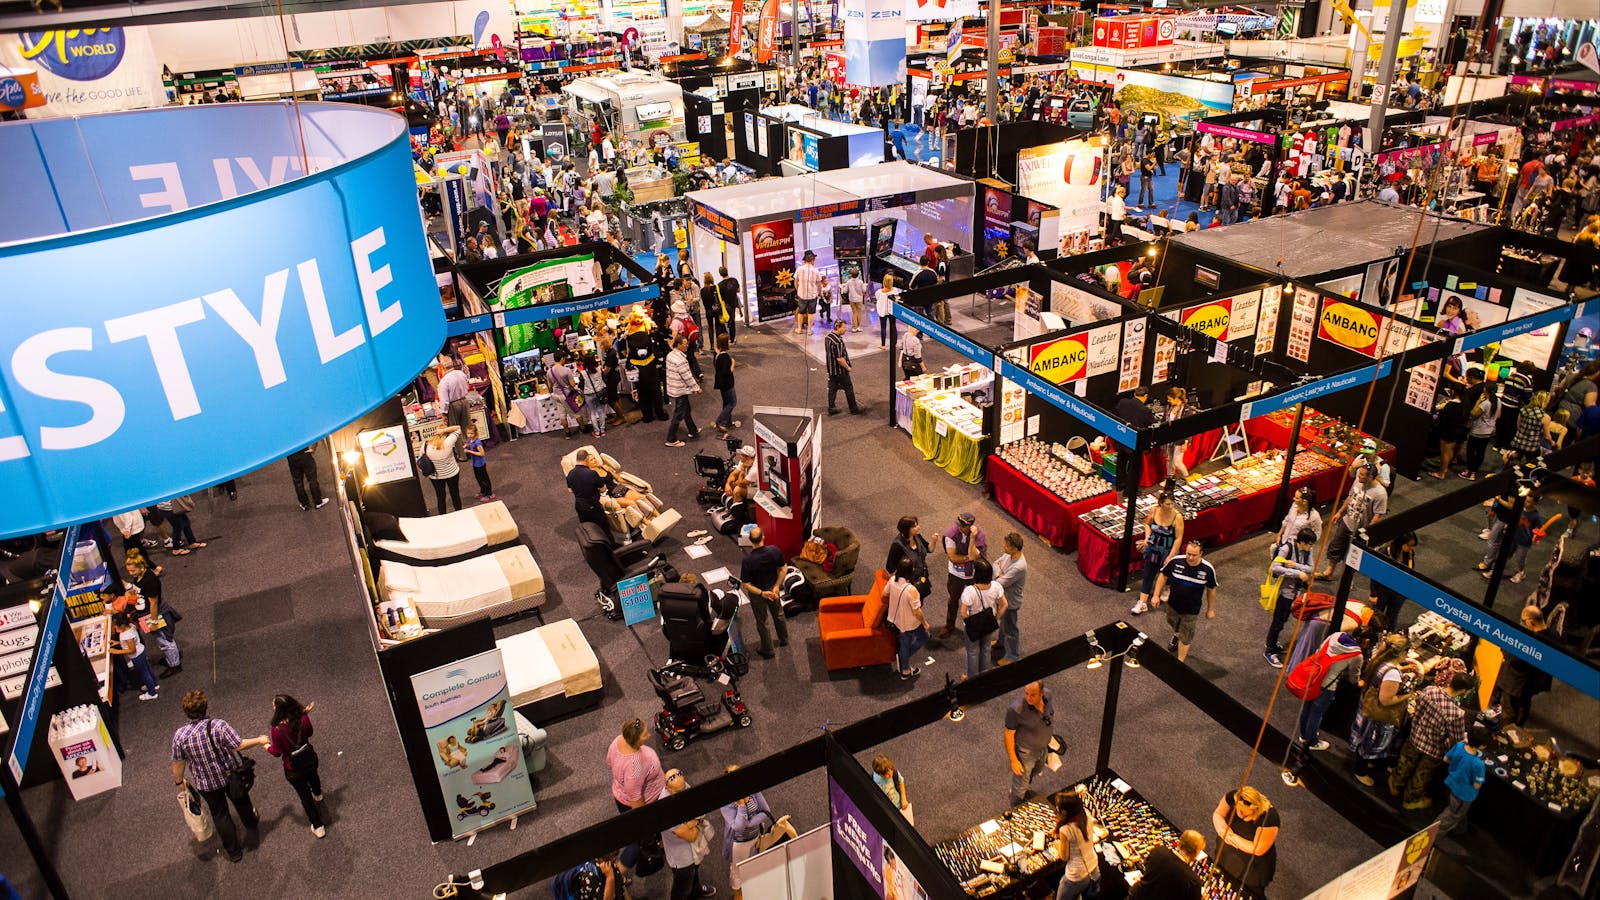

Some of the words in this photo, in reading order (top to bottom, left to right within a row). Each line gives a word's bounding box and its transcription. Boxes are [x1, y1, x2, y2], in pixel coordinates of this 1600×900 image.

[848, 10, 864, 18] ZEN
[871, 10, 901, 18] ZEN
[1163, 26, 1171, 34] 25
[70, 43, 117, 57] WORLD
[45, 91, 63, 103] ive
[66, 87, 87, 103] the
[88, 90, 123, 99] GOOD
[125, 87, 143, 97] LIFE
[551, 307, 565, 315] Free
[576, 302, 594, 311] Bears
[594, 299, 609, 308] Fund
[1324, 311, 1377, 338] AMBANC
[1033, 350, 1086, 372] AMBANC
[1026, 379, 1047, 397] Ambanc
[1046, 389, 1066, 405] Leather
[1070, 402, 1096, 422] Nauticals
[65, 590, 100, 607] NATURE
[621, 587, 635, 598] BUY
[636, 583, 648, 593] ME
[70, 602, 105, 619] LAUNDR
[1434, 597, 1473, 625] Crystal
[1472, 617, 1491, 634] Art
[1491, 628, 1543, 662] Australia
[0, 657, 31, 673] phols
[422, 682, 465, 701] Complete
[466, 669, 502, 686] Comfort
[847, 813, 868, 844] FREE
[844, 822, 872, 860] NERVE
